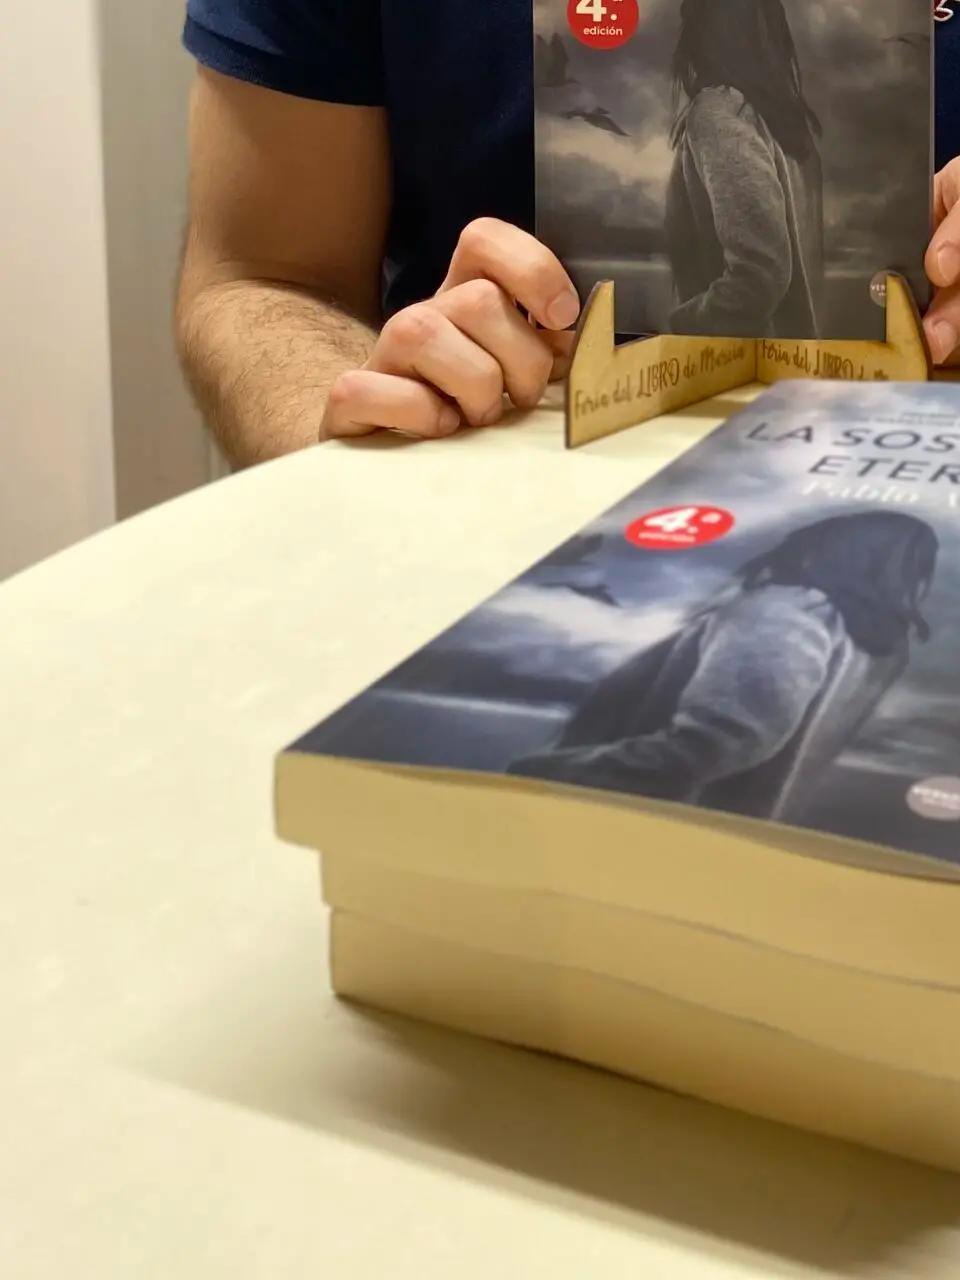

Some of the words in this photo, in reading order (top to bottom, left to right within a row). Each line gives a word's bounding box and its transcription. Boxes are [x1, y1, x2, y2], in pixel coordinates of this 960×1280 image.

[583, 25, 624, 37] edición
[612, 374, 631, 404] del
[636, 357, 681, 398] LIBRO
[743, 421, 813, 446] LA
